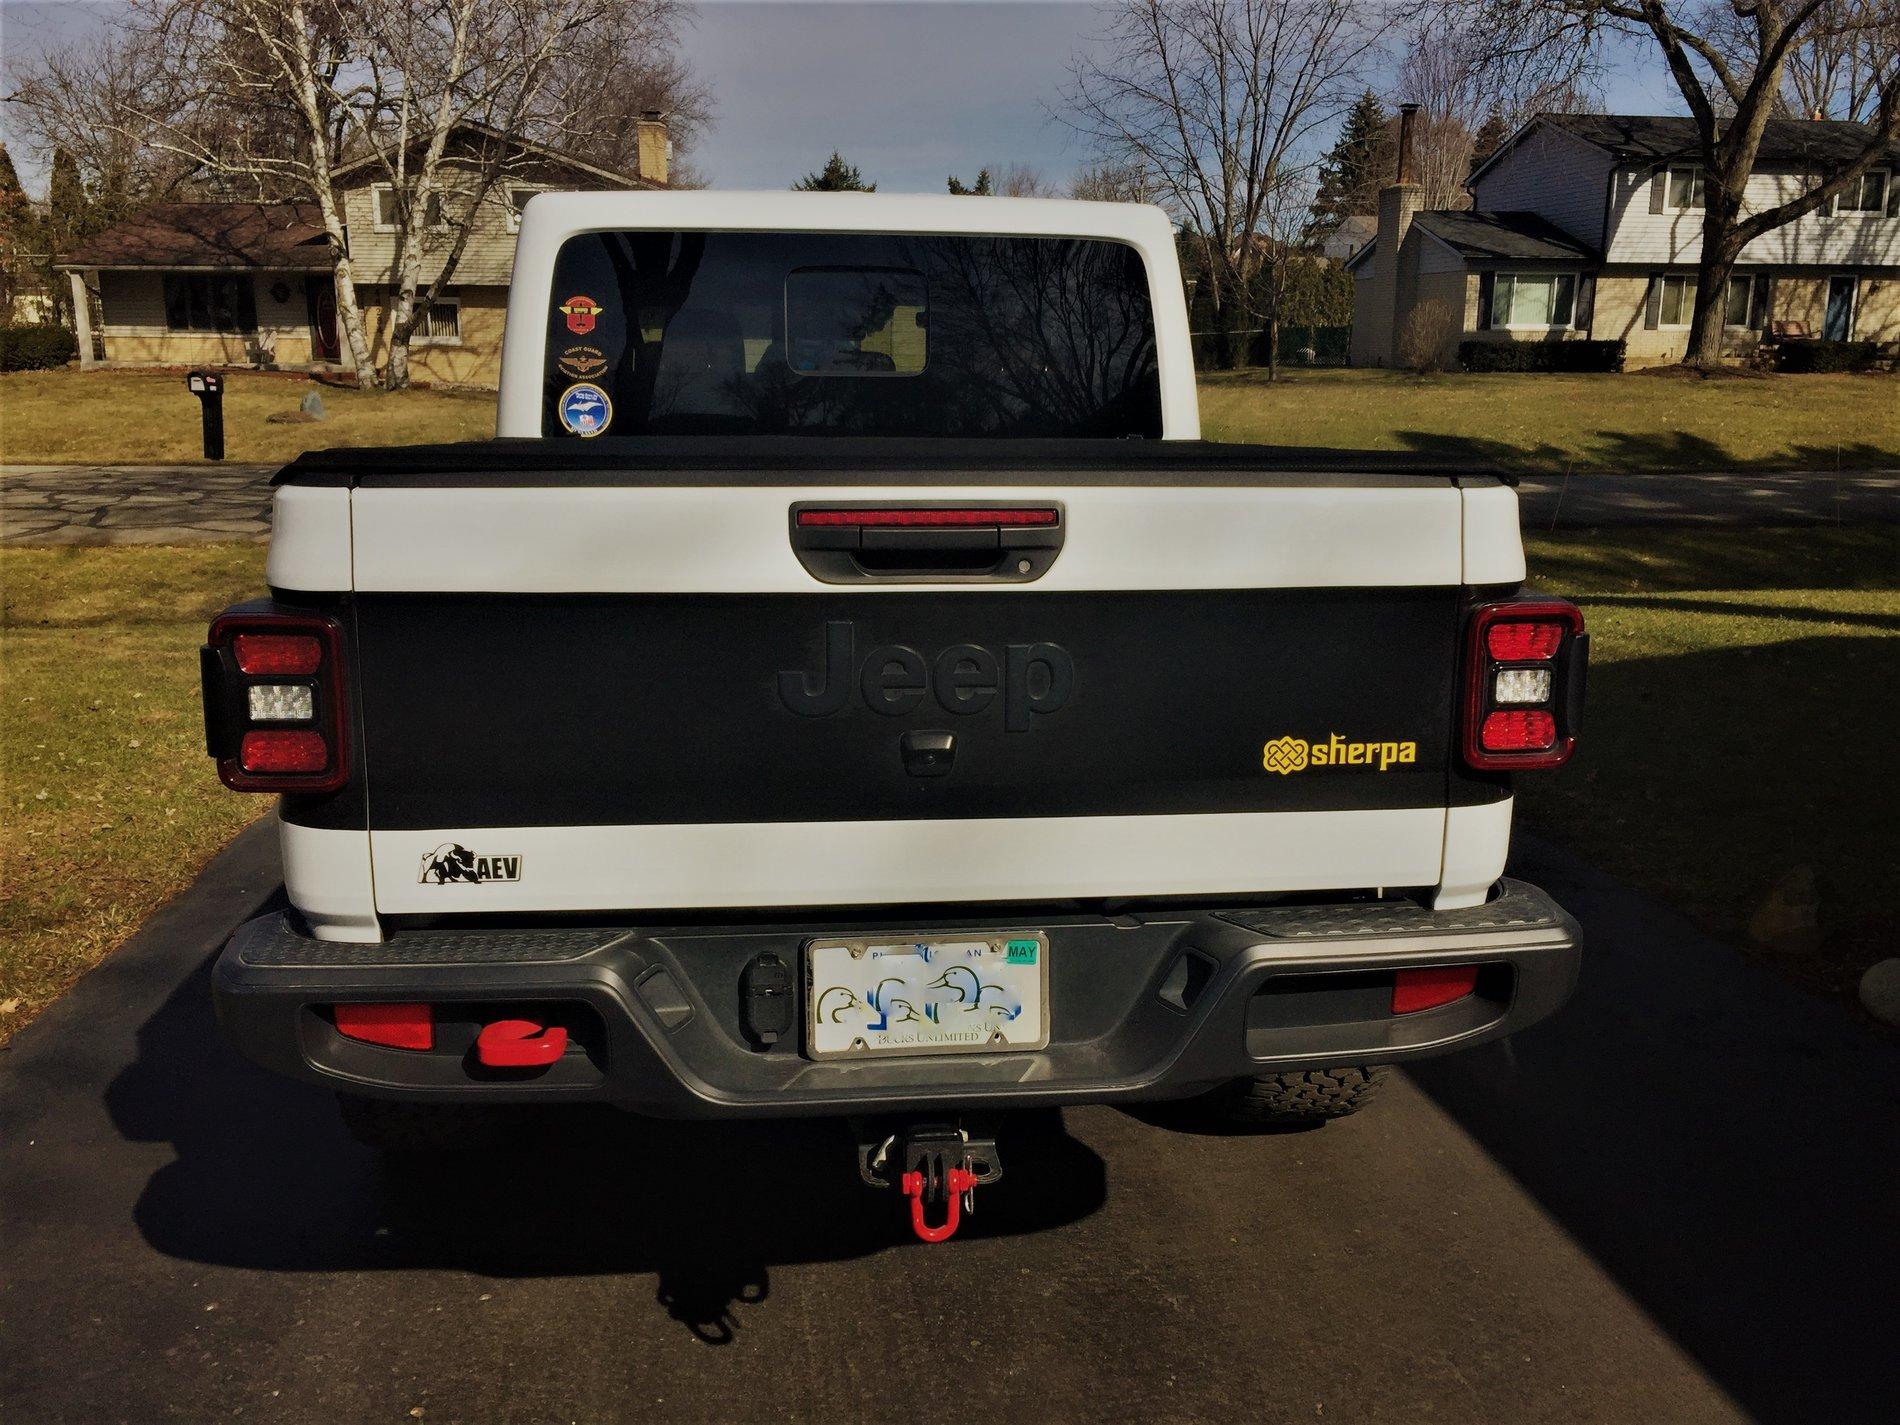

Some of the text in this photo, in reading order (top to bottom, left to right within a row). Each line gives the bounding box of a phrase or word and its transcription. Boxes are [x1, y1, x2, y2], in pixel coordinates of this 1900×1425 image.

[564, 346, 602, 356] COAST GUARD
[777, 620, 1075, 733] Jeep
[1311, 731, 1416, 771] sherpa
[477, 857, 518, 879] AEV
[1008, 946, 1036, 958] MAY
